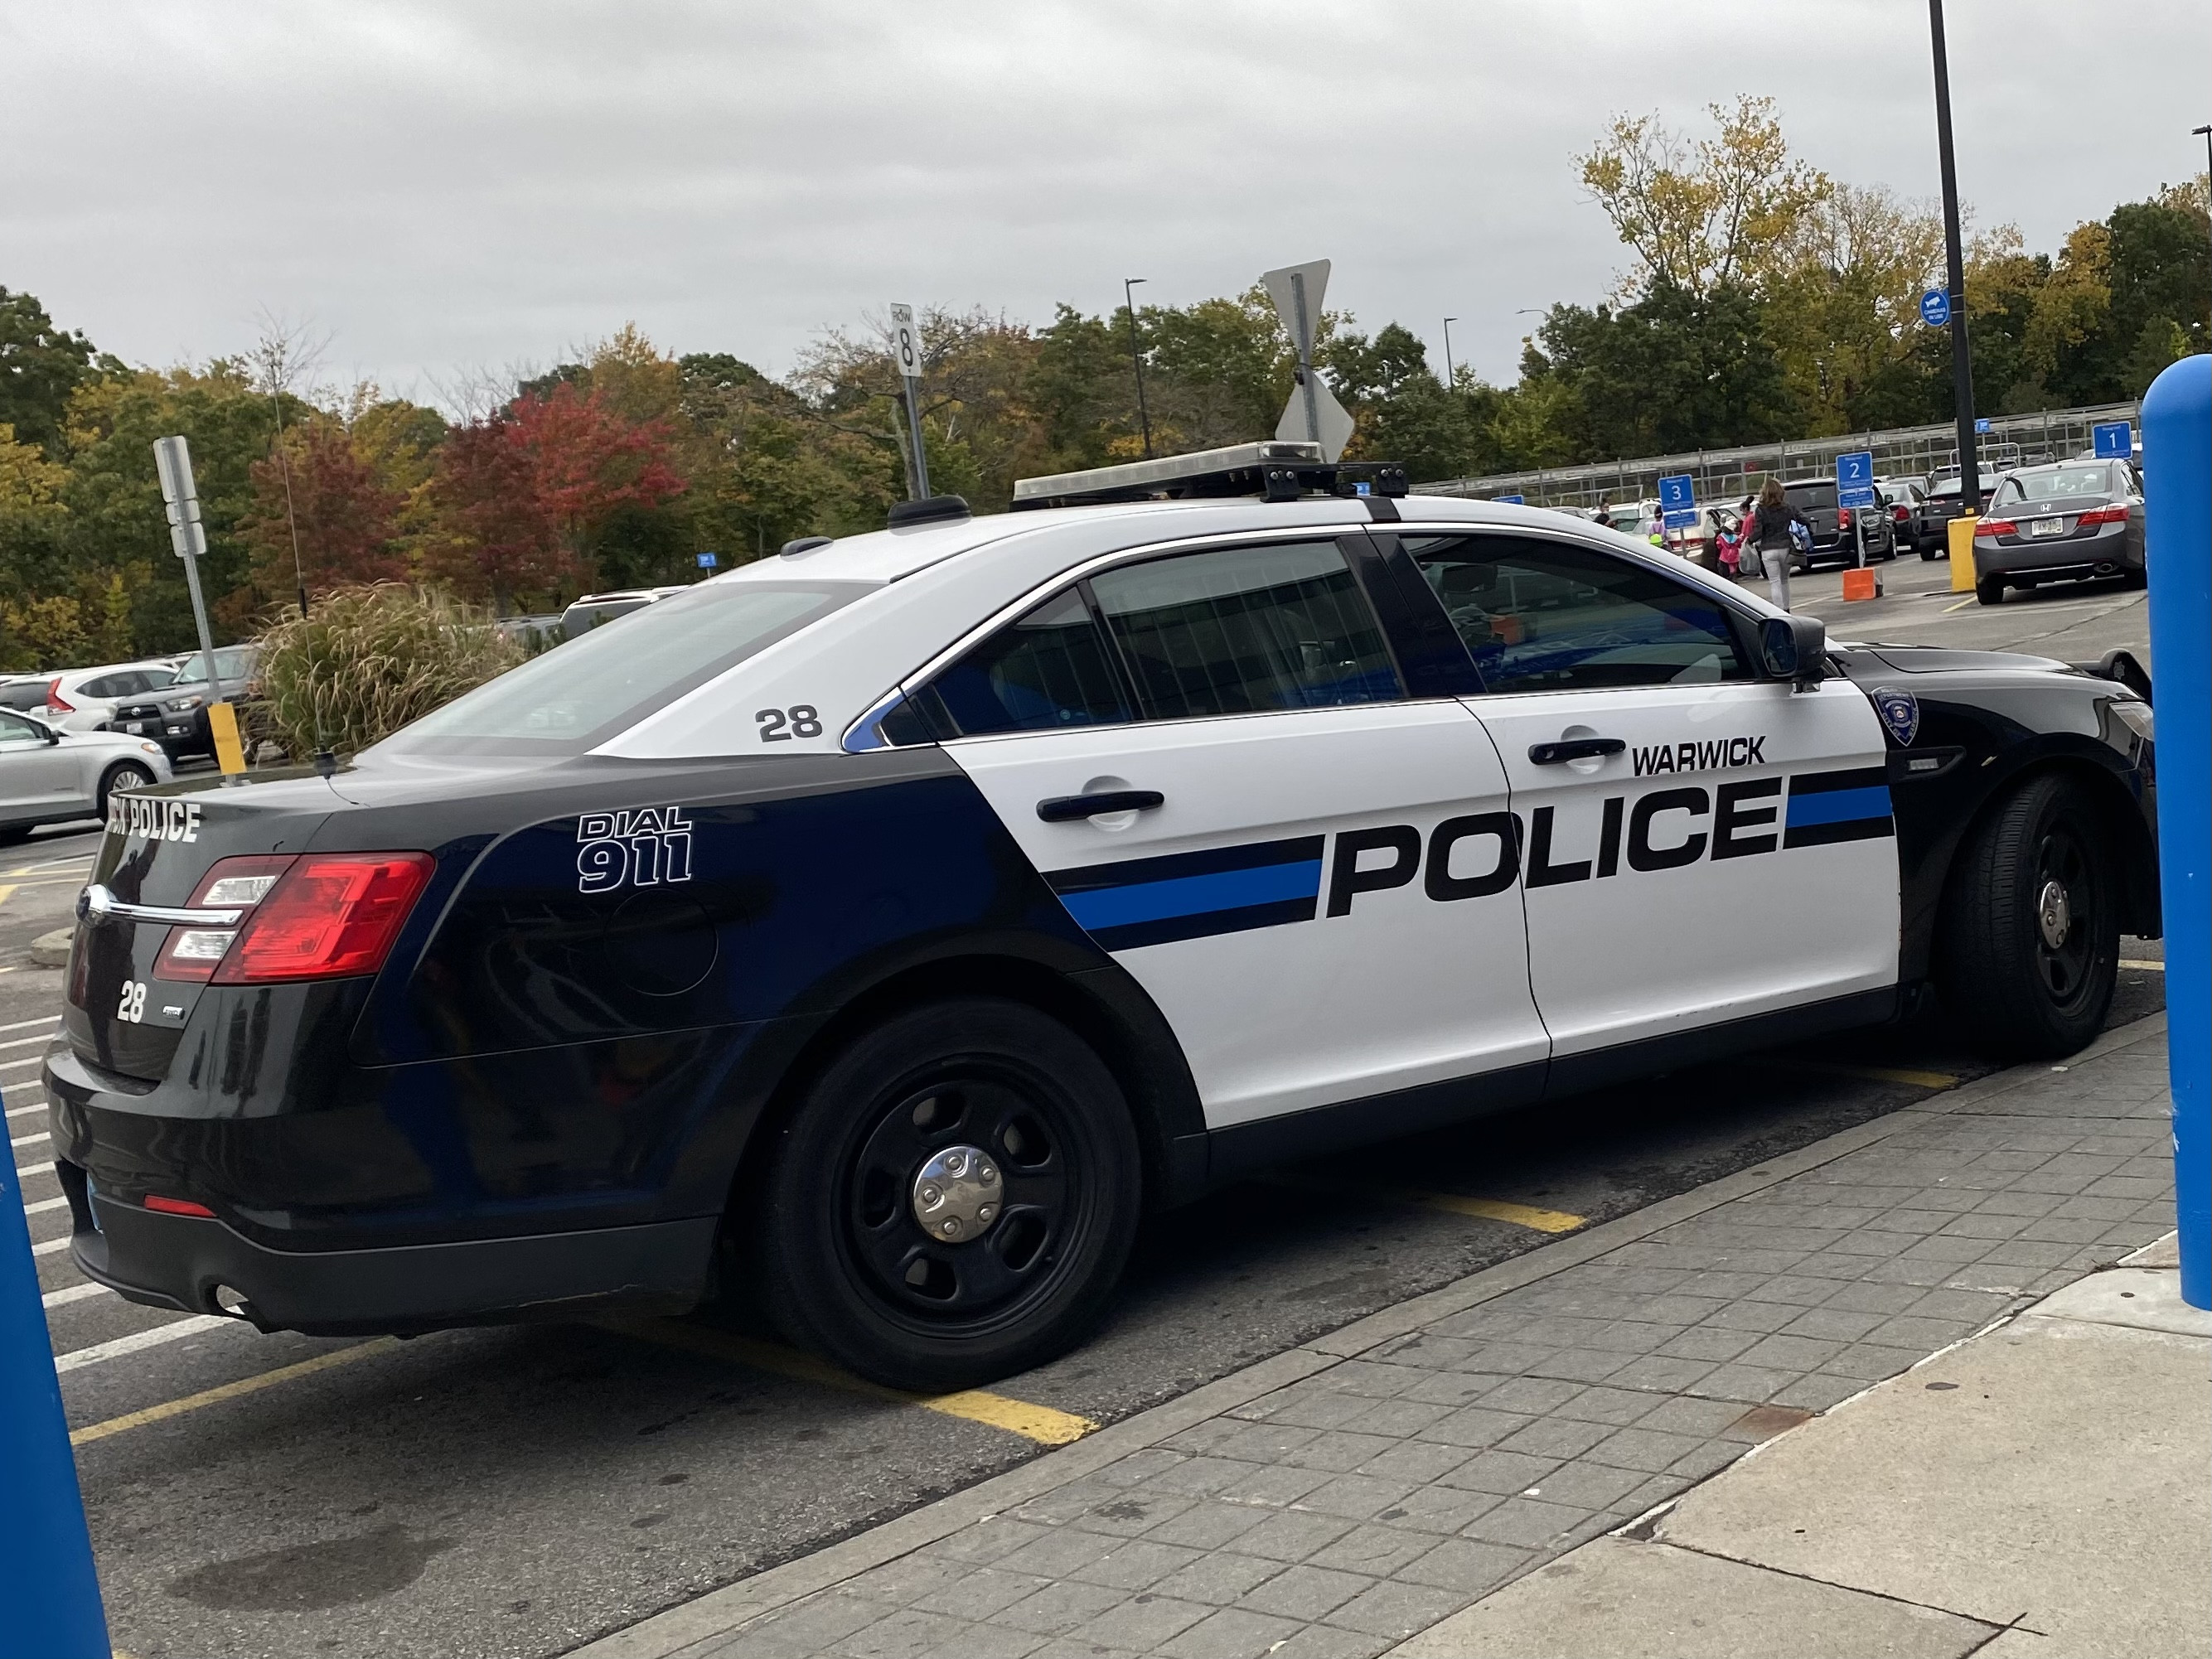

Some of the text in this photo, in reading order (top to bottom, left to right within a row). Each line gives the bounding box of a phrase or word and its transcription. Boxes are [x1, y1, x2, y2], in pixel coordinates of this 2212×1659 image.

[899, 327, 913, 366] 8
[2108, 432, 2116, 449] 1
[1849, 462, 1861, 479] 2
[1671, 485, 1682, 501] 3
[755, 704, 822, 742] 28
[1632, 736, 1766, 776] WARWICK
[128, 799, 201, 843] POLICE
[577, 806, 692, 843] DIAL
[577, 832, 692, 893] 911
[1326, 776, 1782, 918] POLICE
[117, 979, 147, 1023] 28
